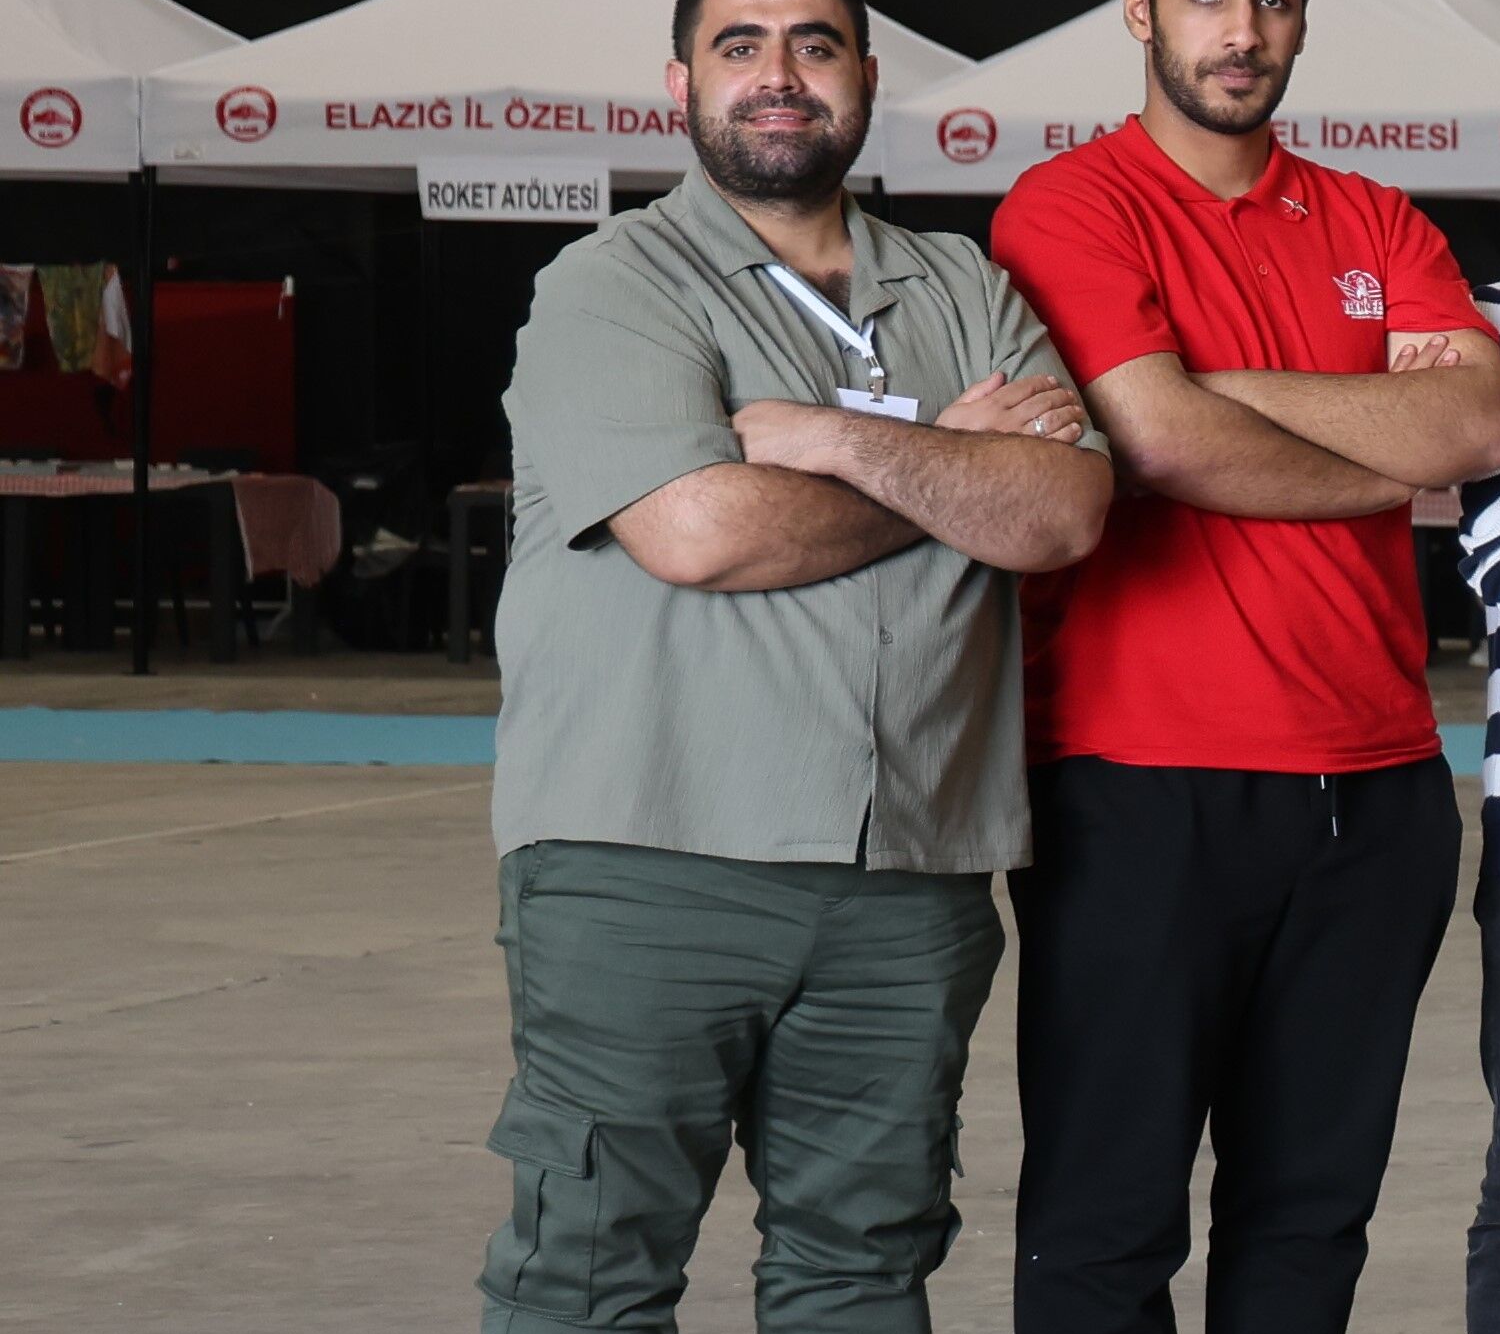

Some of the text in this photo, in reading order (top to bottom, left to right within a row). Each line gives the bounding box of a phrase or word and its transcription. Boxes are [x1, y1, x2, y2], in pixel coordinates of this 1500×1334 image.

[325, 97, 689, 136] ELAZIĞ İL ÖZEL İDAR
[1270, 120, 1311, 148] EL
[1321, 115, 1459, 152] İDARESİ
[427, 177, 598, 212] ROKET ATÖLYESİ
